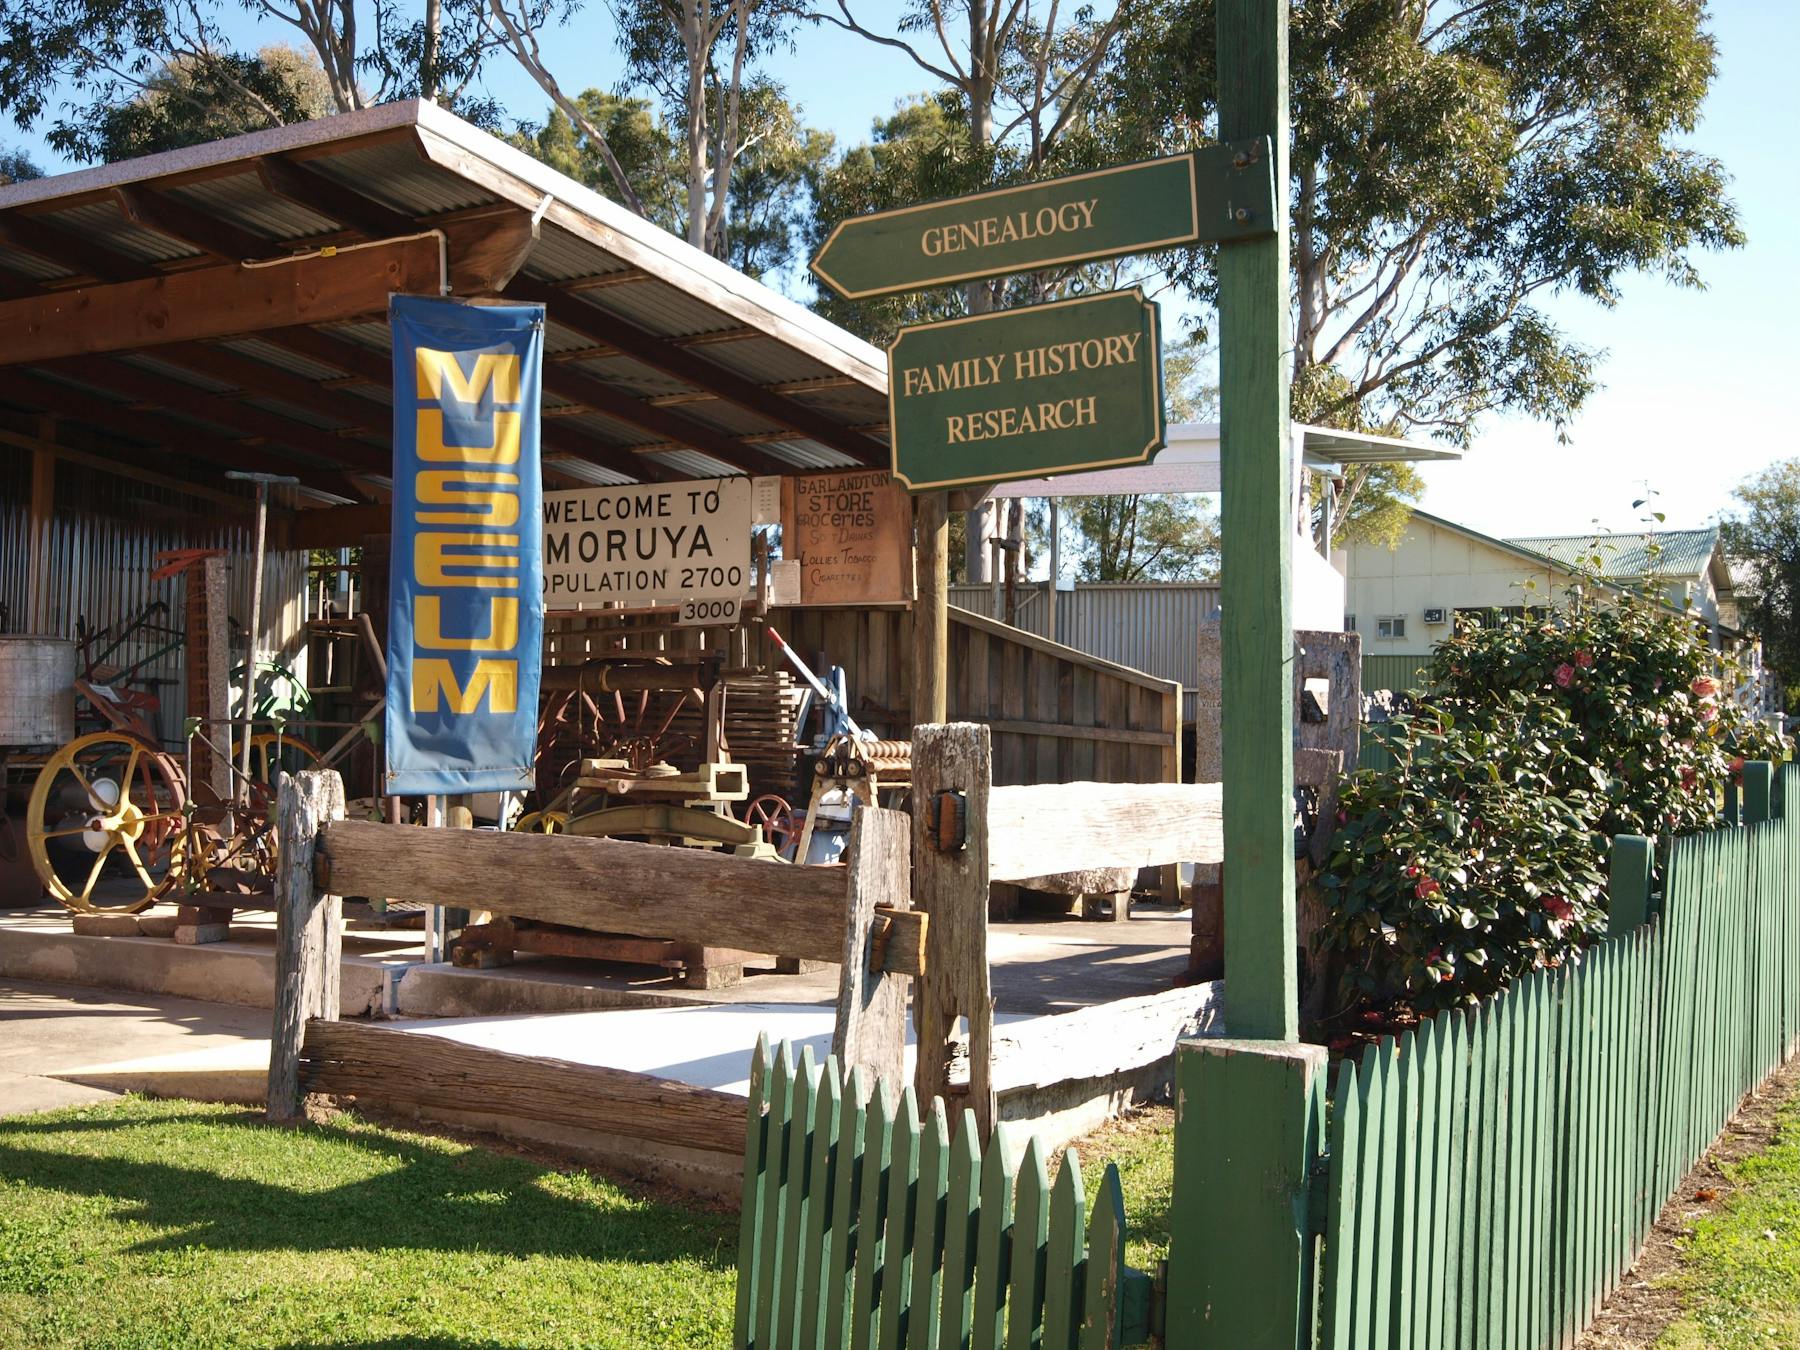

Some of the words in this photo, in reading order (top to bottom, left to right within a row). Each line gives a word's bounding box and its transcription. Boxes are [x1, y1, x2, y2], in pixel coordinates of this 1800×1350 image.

[921, 199, 1097, 257] GENEALOGY
[903, 354, 1006, 398] FAMILY
[1015, 332, 1142, 380] HISTORY
[946, 397, 1097, 445] RESEARCH
[544, 493, 671, 524] WELCOME
[687, 490, 720, 515] TO
[809, 493, 874, 512] STORE
[410, 347, 520, 714] MUSEUM
[547, 525, 713, 564] MORUYA
[681, 566, 741, 589] 2700
[684, 601, 735, 620] 3000
